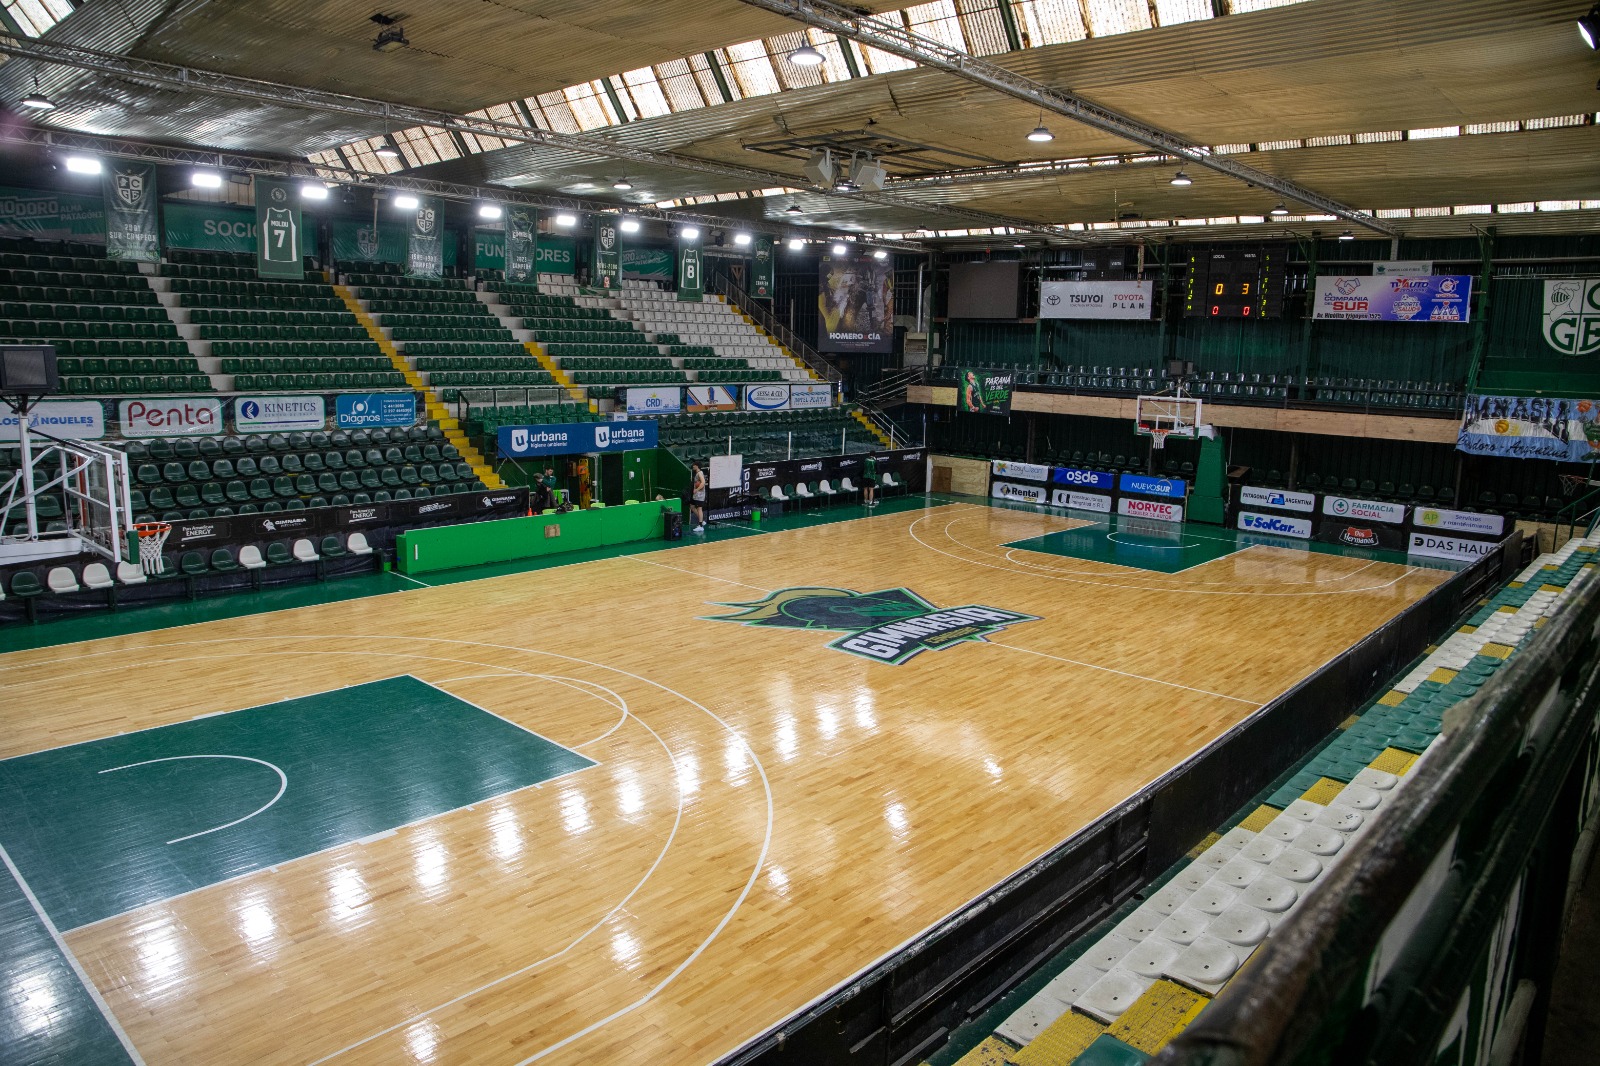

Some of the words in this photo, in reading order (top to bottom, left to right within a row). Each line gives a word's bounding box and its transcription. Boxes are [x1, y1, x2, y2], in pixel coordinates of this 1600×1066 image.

[273, 229, 285, 248] 7
[687, 265, 695, 279] 8
[1215, 283, 1224, 295] 0
[1241, 283, 1250, 295] 3
[1070, 295, 1104, 303] TSUYOI
[1212, 305, 1219, 315] 0
[1242, 306, 1251, 316] 0
[1333, 301, 1369, 311] SUR
[829, 332, 864, 340] HOMERO
[985, 389, 1009, 401] VERDE
[264, 402, 316, 413] KINETICS
[645, 398, 661, 408] CRD
[128, 401, 214, 427] Penta
[530, 431, 568, 442] urbana
[611, 428, 645, 438] urbana
[1011, 487, 1039, 498] Rental
[1127, 500, 1173, 515] NORVEC
[1352, 502, 1394, 514] FARMACIA
[352, 511, 373, 520] ENERGY
[1351, 508, 1382, 519] SOCIAL
[1423, 512, 1439, 521] AP
[1455, 514, 1482, 522] Servicios
[1253, 516, 1295, 533] SolCar
[1447, 520, 1493, 531] mantenimiento
[186, 529, 212, 537] ENERGY
[1343, 532, 1375, 545] Hermanos
[1426, 538, 1454, 551] DAS
[842, 608, 1018, 658] GIMNASIA
